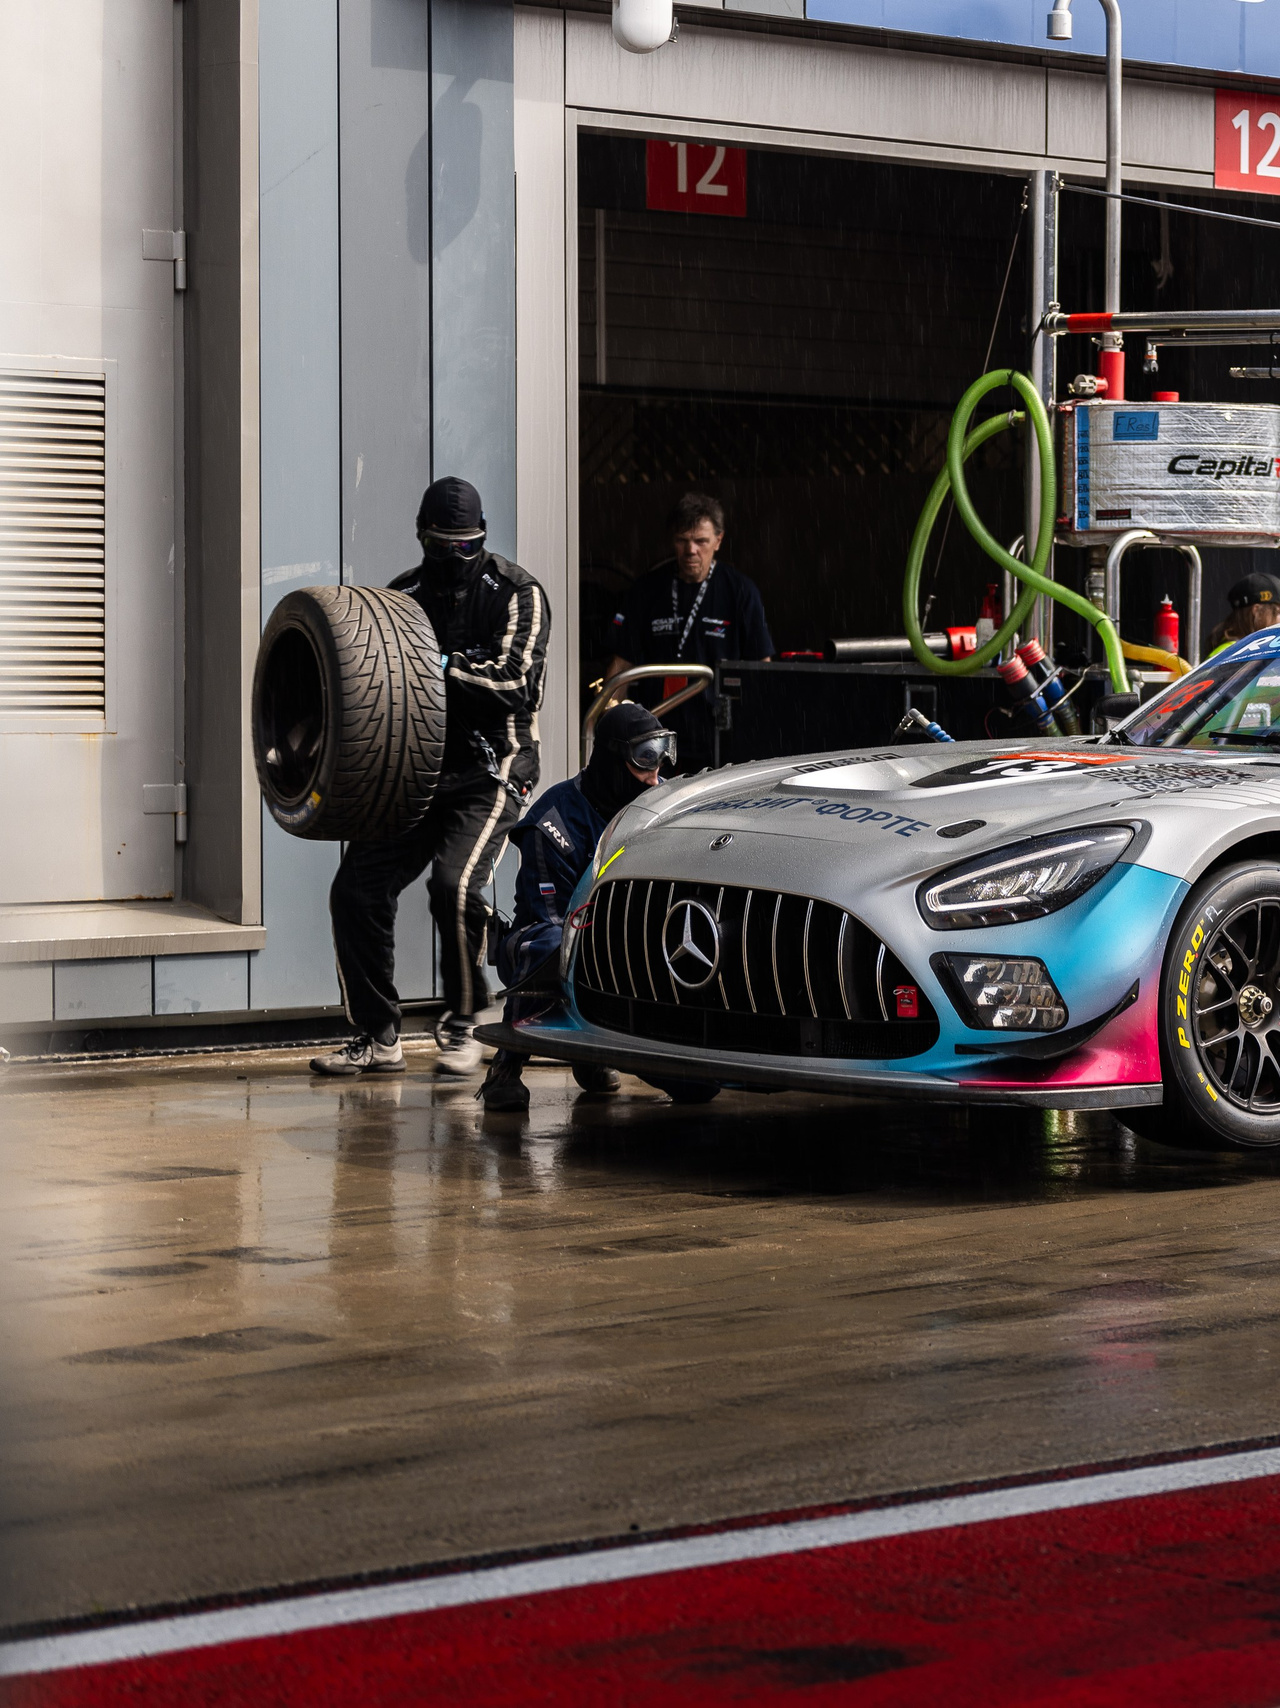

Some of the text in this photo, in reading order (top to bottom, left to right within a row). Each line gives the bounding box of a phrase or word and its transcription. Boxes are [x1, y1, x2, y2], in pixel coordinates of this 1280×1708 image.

[668, 141, 728, 196] 12
[969, 758, 1077, 776] 13
[543, 820, 570, 849] HRX
[815, 802, 932, 838] ФОРТЕ
[1177, 925, 1205, 1049] P ZERO
